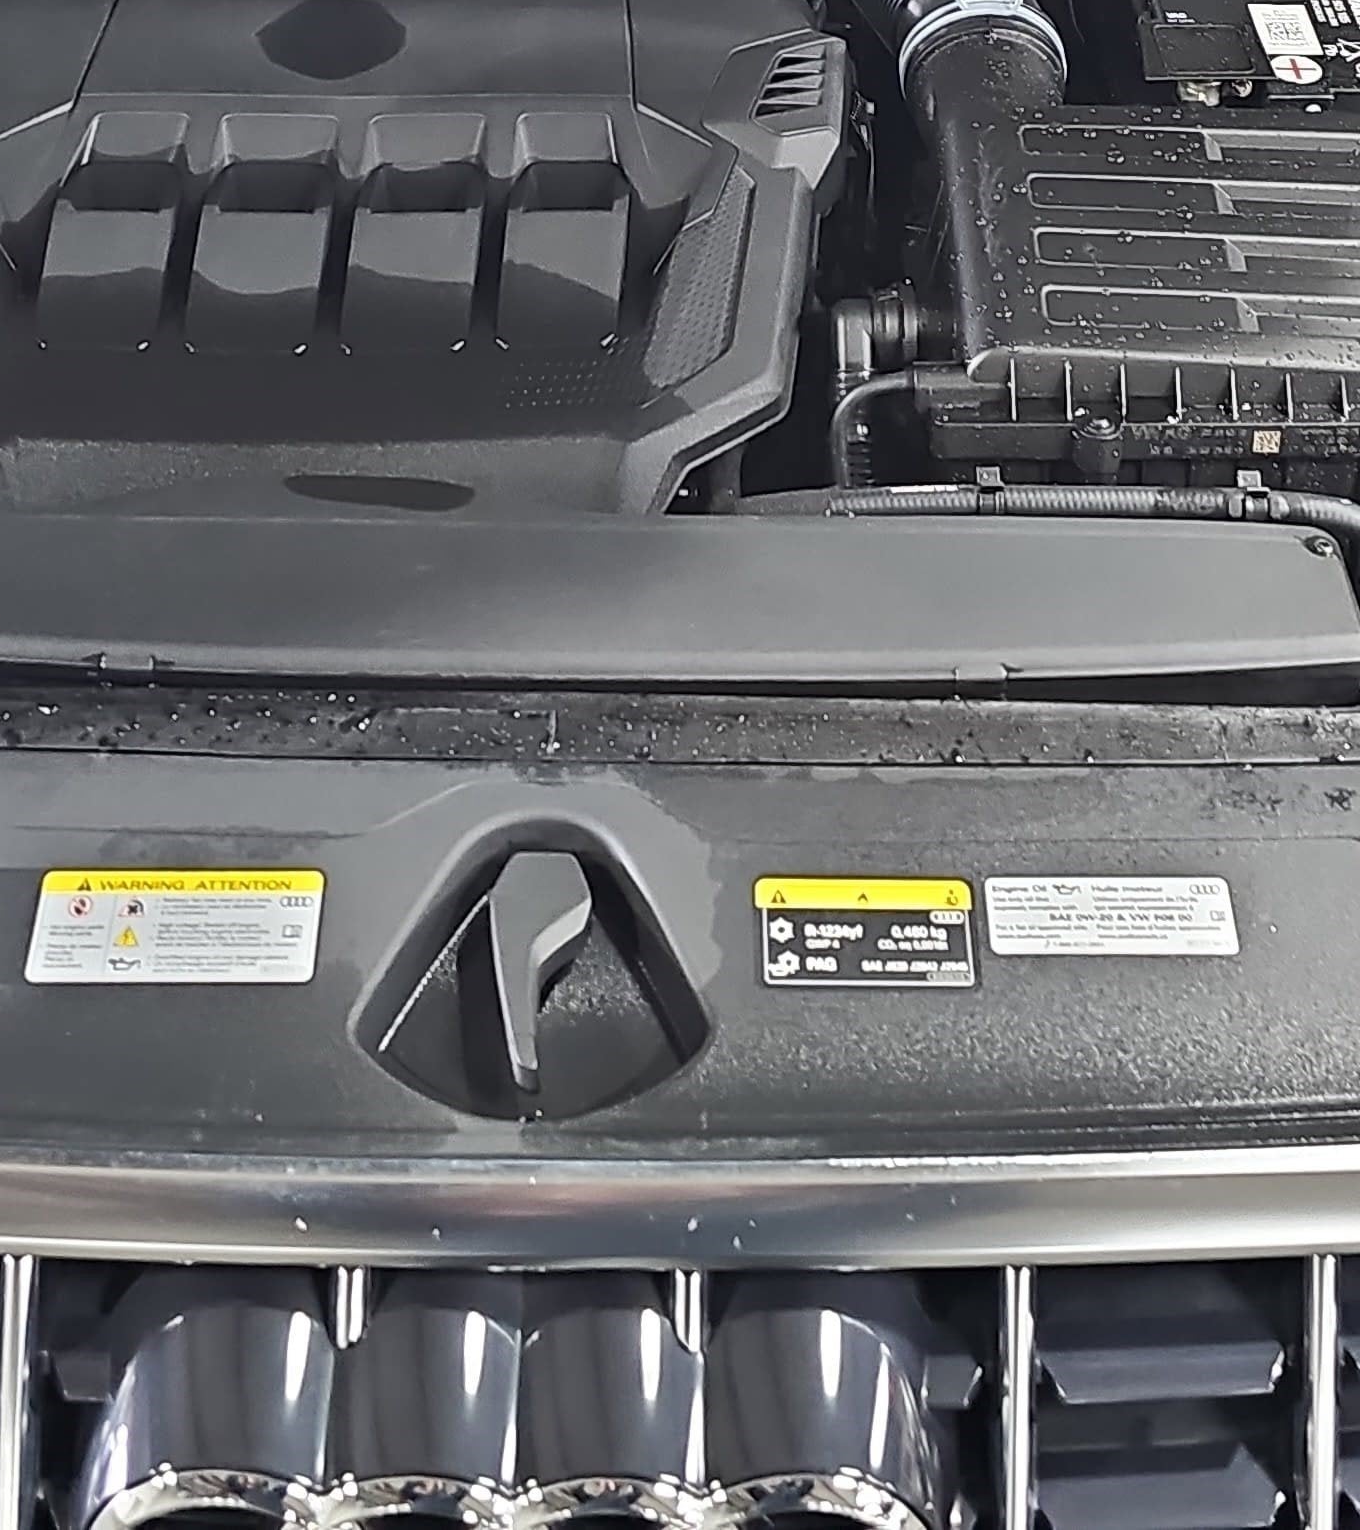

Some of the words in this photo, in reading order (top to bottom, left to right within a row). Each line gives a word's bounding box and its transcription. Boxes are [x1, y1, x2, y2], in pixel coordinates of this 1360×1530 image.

[1322, 43, 1339, 57] Pb
[100, 879, 185, 891] WARNING
[195, 879, 292, 891] ATTENTION
[804, 923, 864, 940] R-1234yf
[805, 956, 838, 972] PAG
